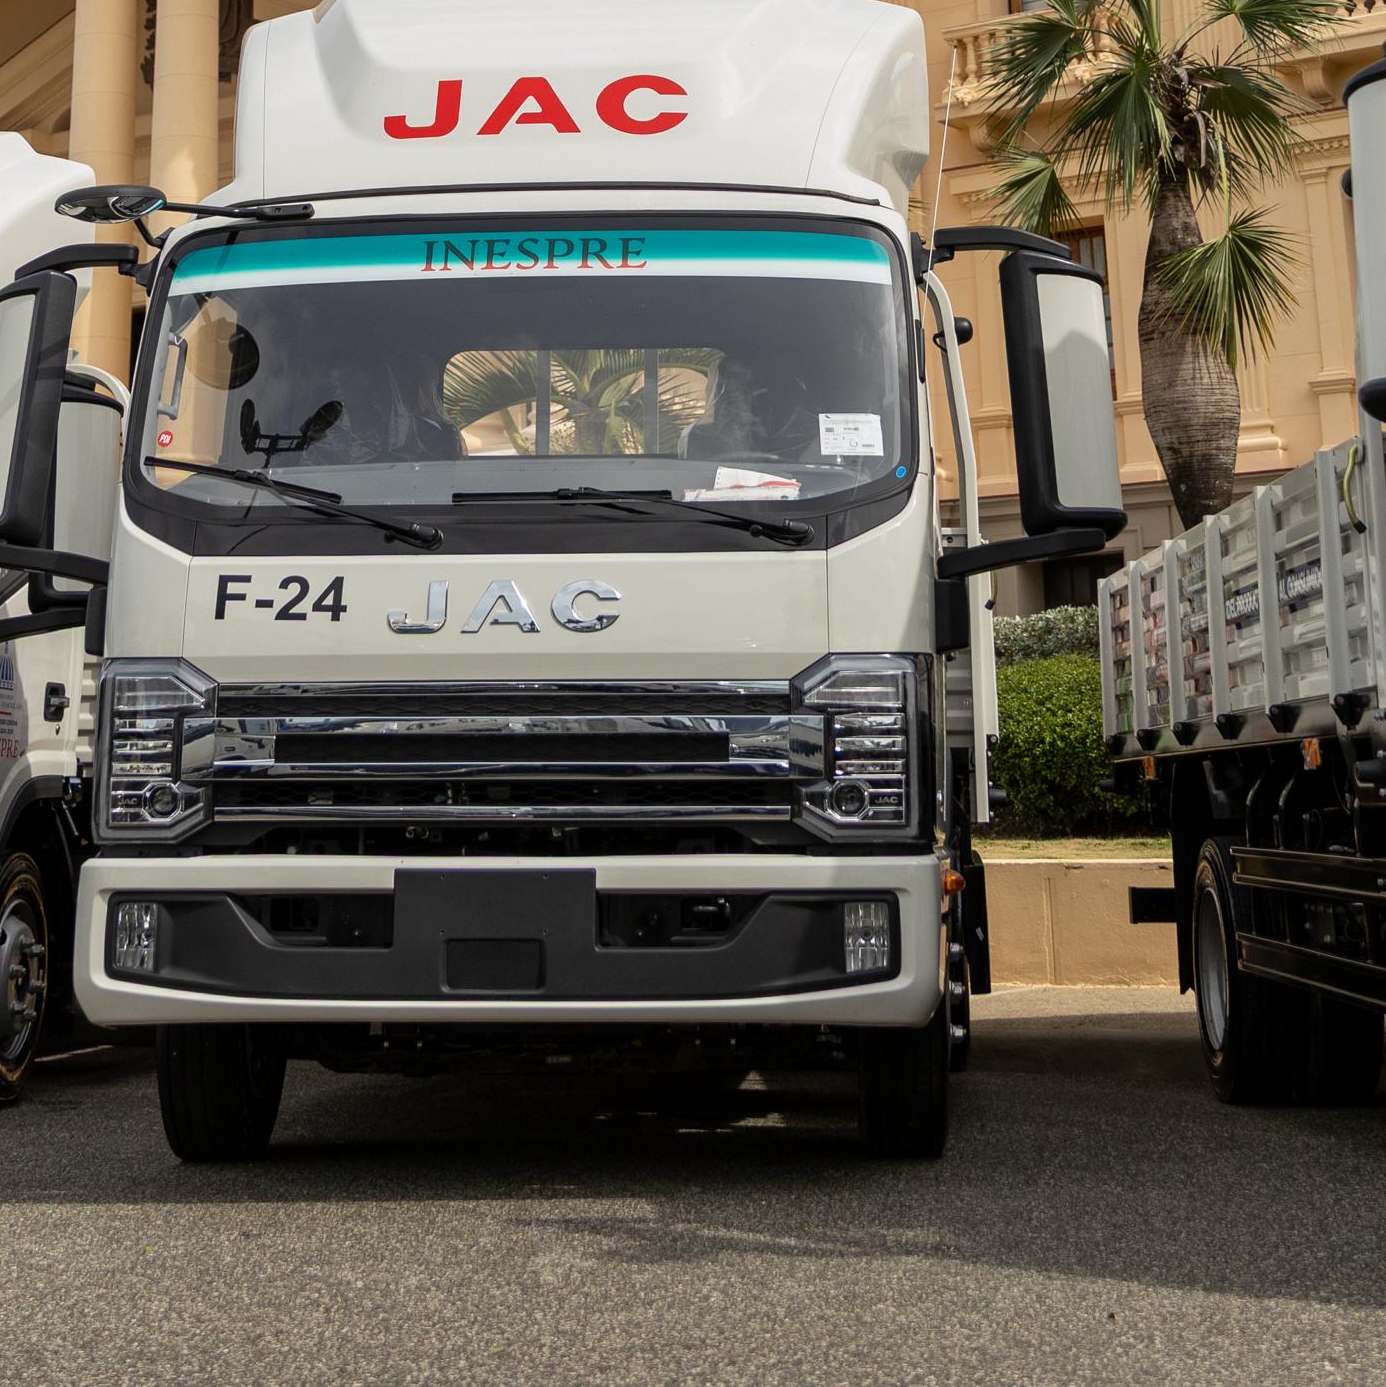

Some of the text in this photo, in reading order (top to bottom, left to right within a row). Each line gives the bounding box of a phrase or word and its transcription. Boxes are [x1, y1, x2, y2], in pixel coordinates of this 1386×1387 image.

[383, 73, 688, 140] JAC
[420, 236, 649, 273] INESPRE
[214, 574, 348, 622] F-24
[386, 578, 622, 634] JAC
[875, 796, 899, 804] JAC
